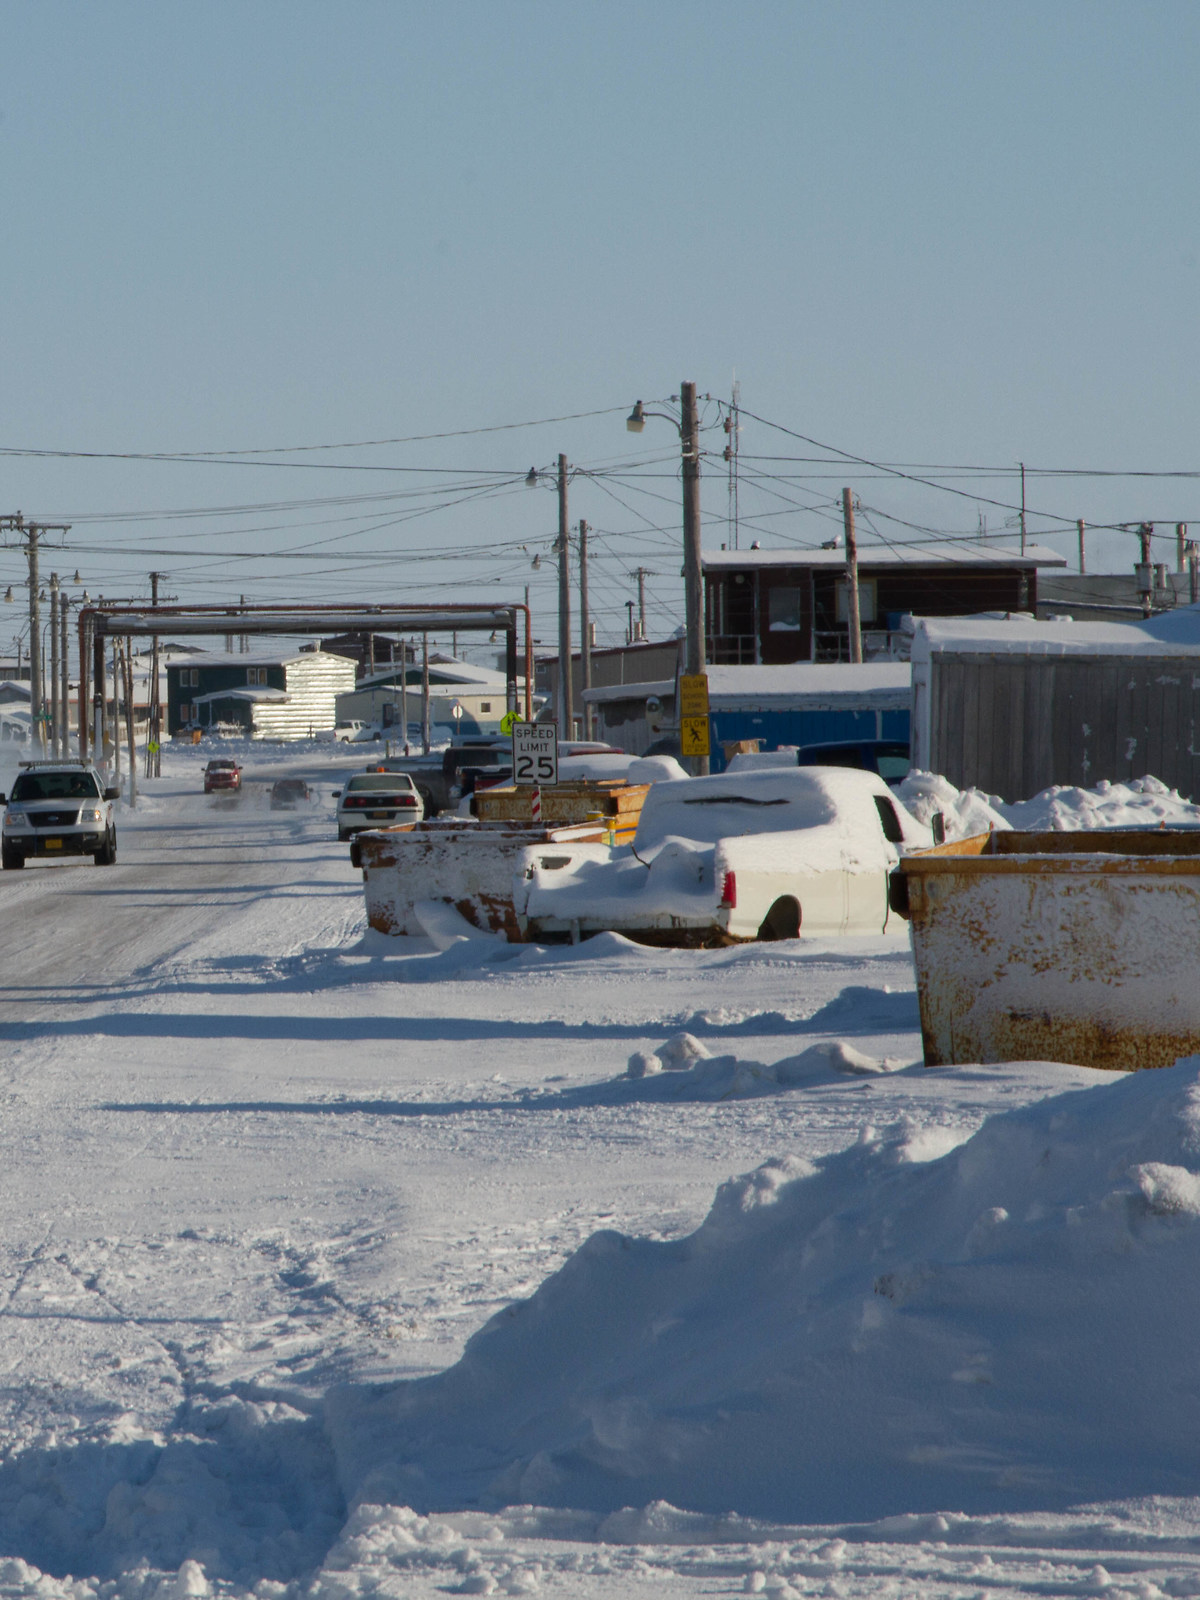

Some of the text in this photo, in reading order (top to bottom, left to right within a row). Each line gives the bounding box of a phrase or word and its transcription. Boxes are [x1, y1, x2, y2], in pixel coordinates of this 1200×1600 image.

[682, 681, 705, 689] SLOW
[683, 720, 706, 729] SLOW
[516, 729, 554, 739] SPEED
[520, 742, 549, 752] LIMIT
[517, 755, 554, 779] 25
